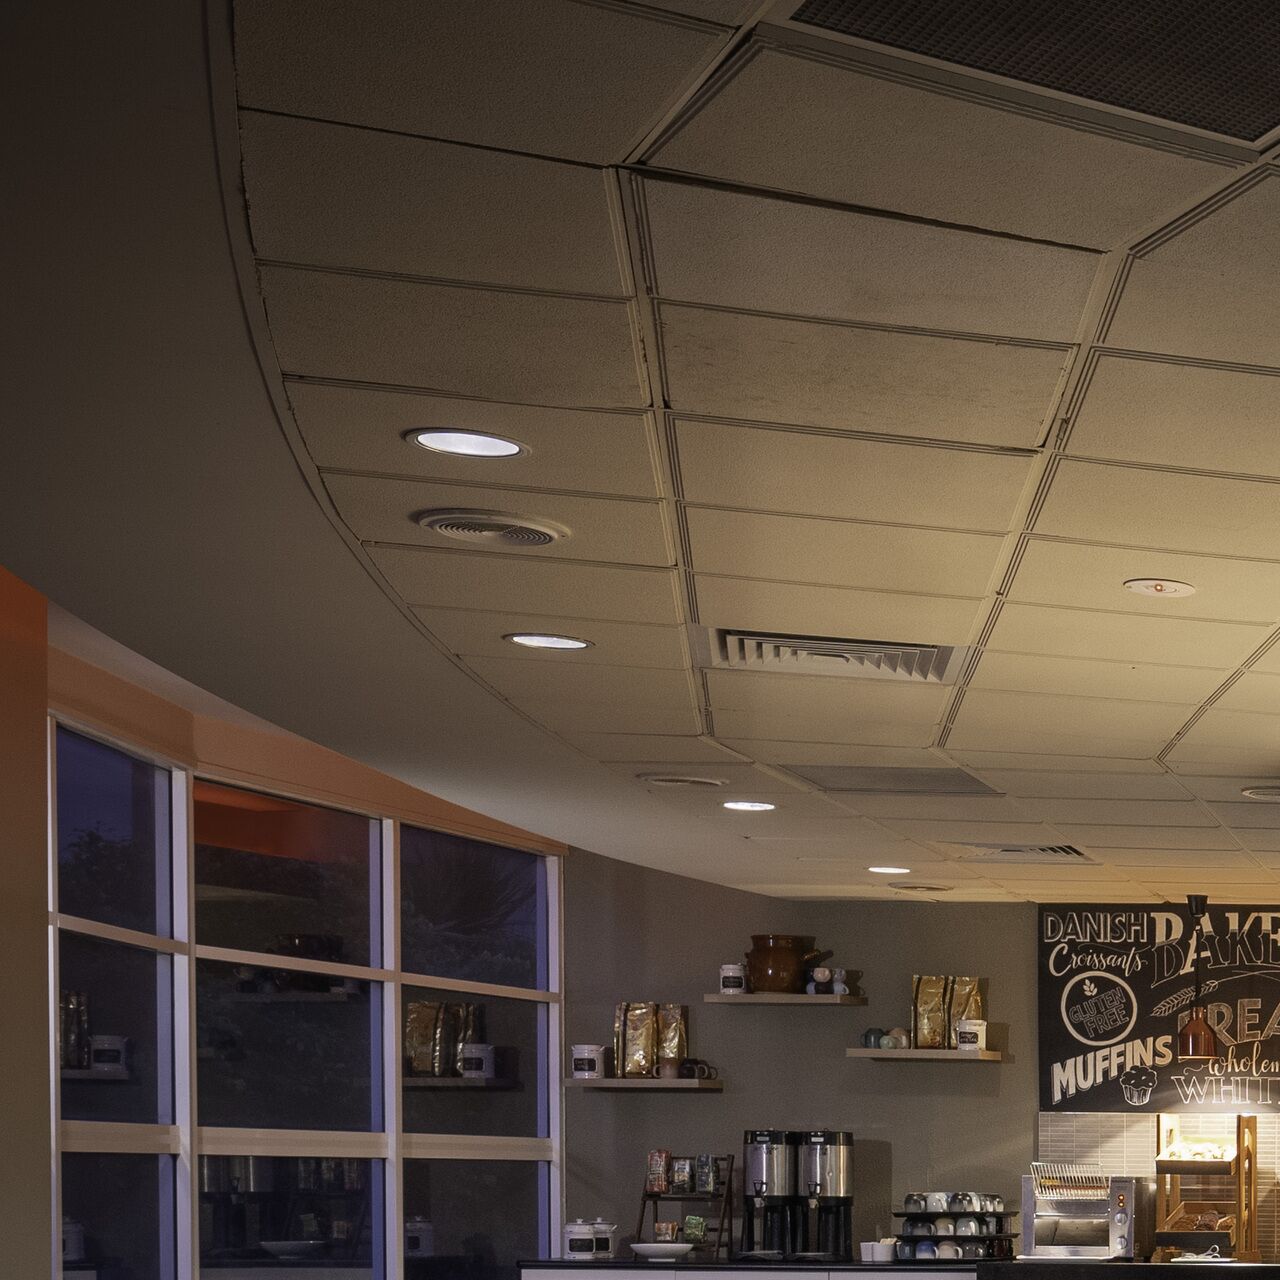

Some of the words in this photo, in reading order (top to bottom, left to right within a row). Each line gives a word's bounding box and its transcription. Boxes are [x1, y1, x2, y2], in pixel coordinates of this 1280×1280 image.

[1043, 911, 1148, 943] DANISH
[1048, 943, 1148, 977] Croissants
[1069, 986, 1125, 1023] GLUTEN
[1083, 1002, 1130, 1038] FREE
[1052, 1034, 1173, 1105] MUFFINS
